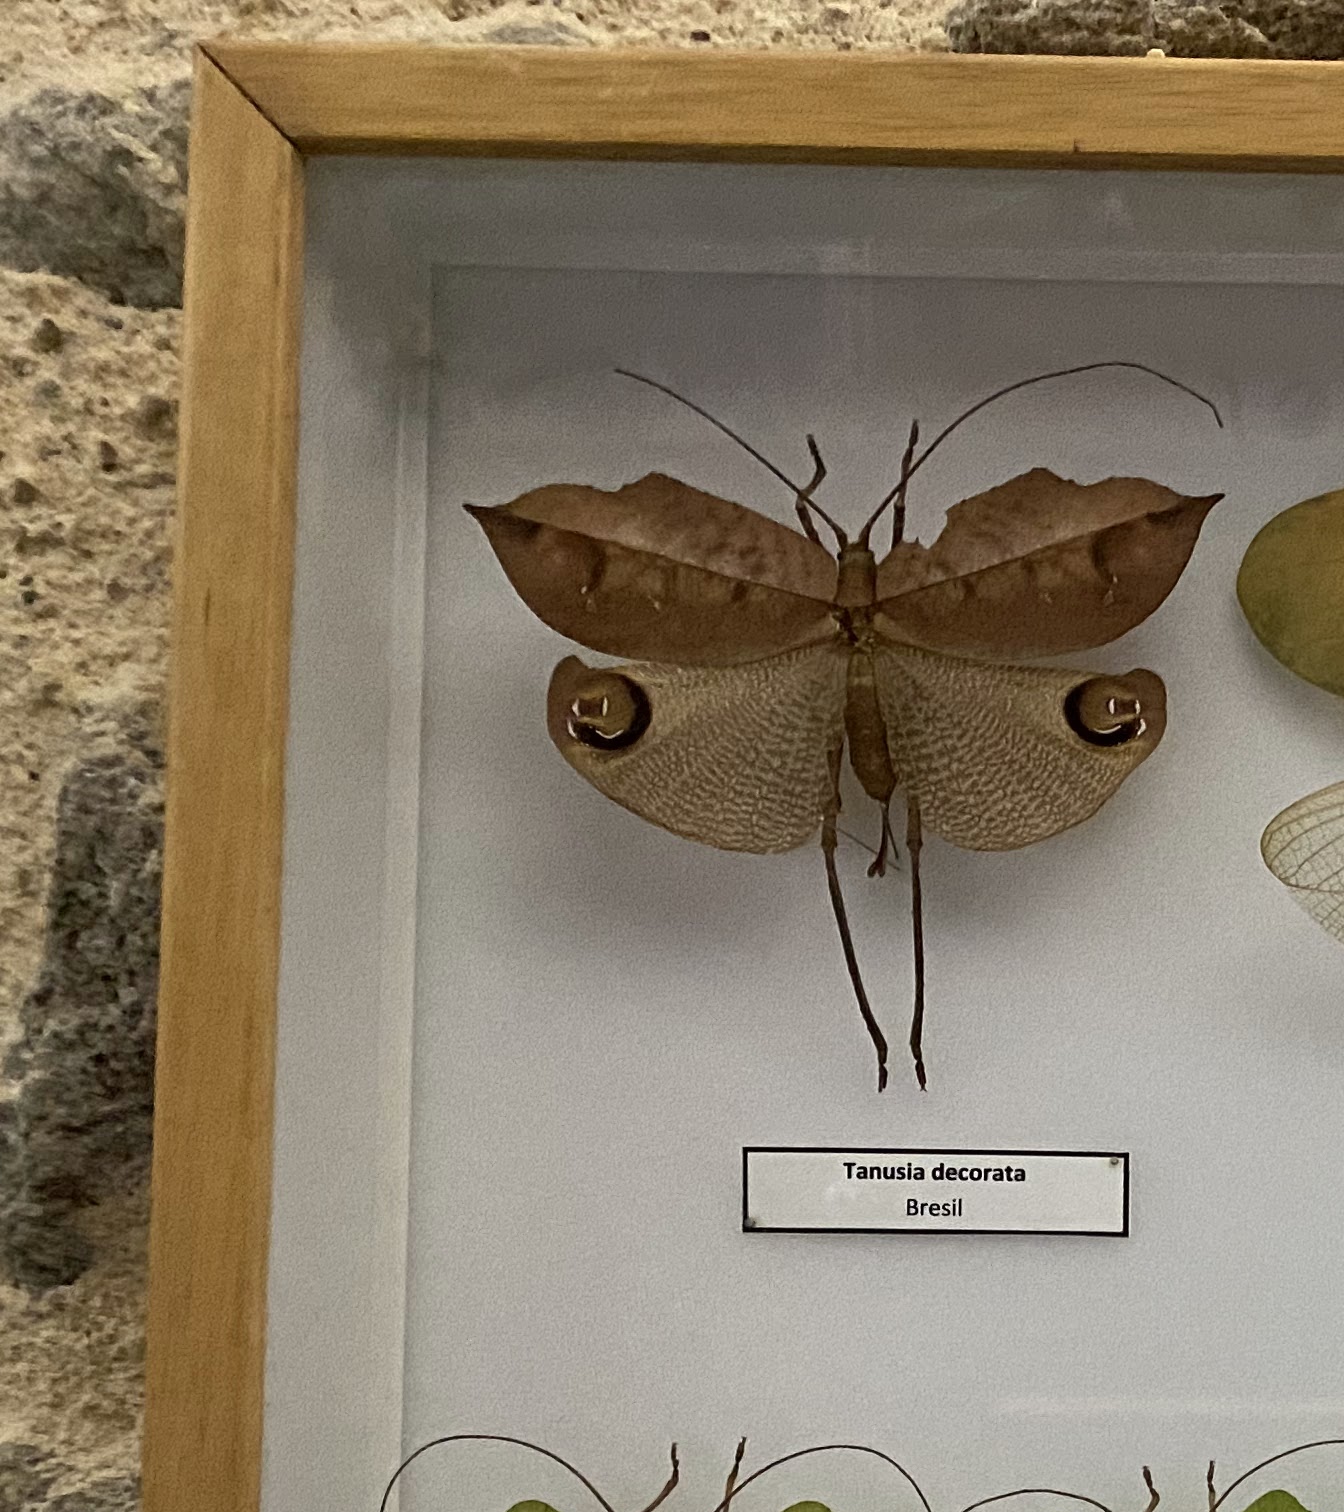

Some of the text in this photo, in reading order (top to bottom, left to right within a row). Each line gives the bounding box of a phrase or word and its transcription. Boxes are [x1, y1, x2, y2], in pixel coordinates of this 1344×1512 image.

[843, 1162, 1026, 1182] Tanusia decorata
[906, 1198, 962, 1216] Bresil
